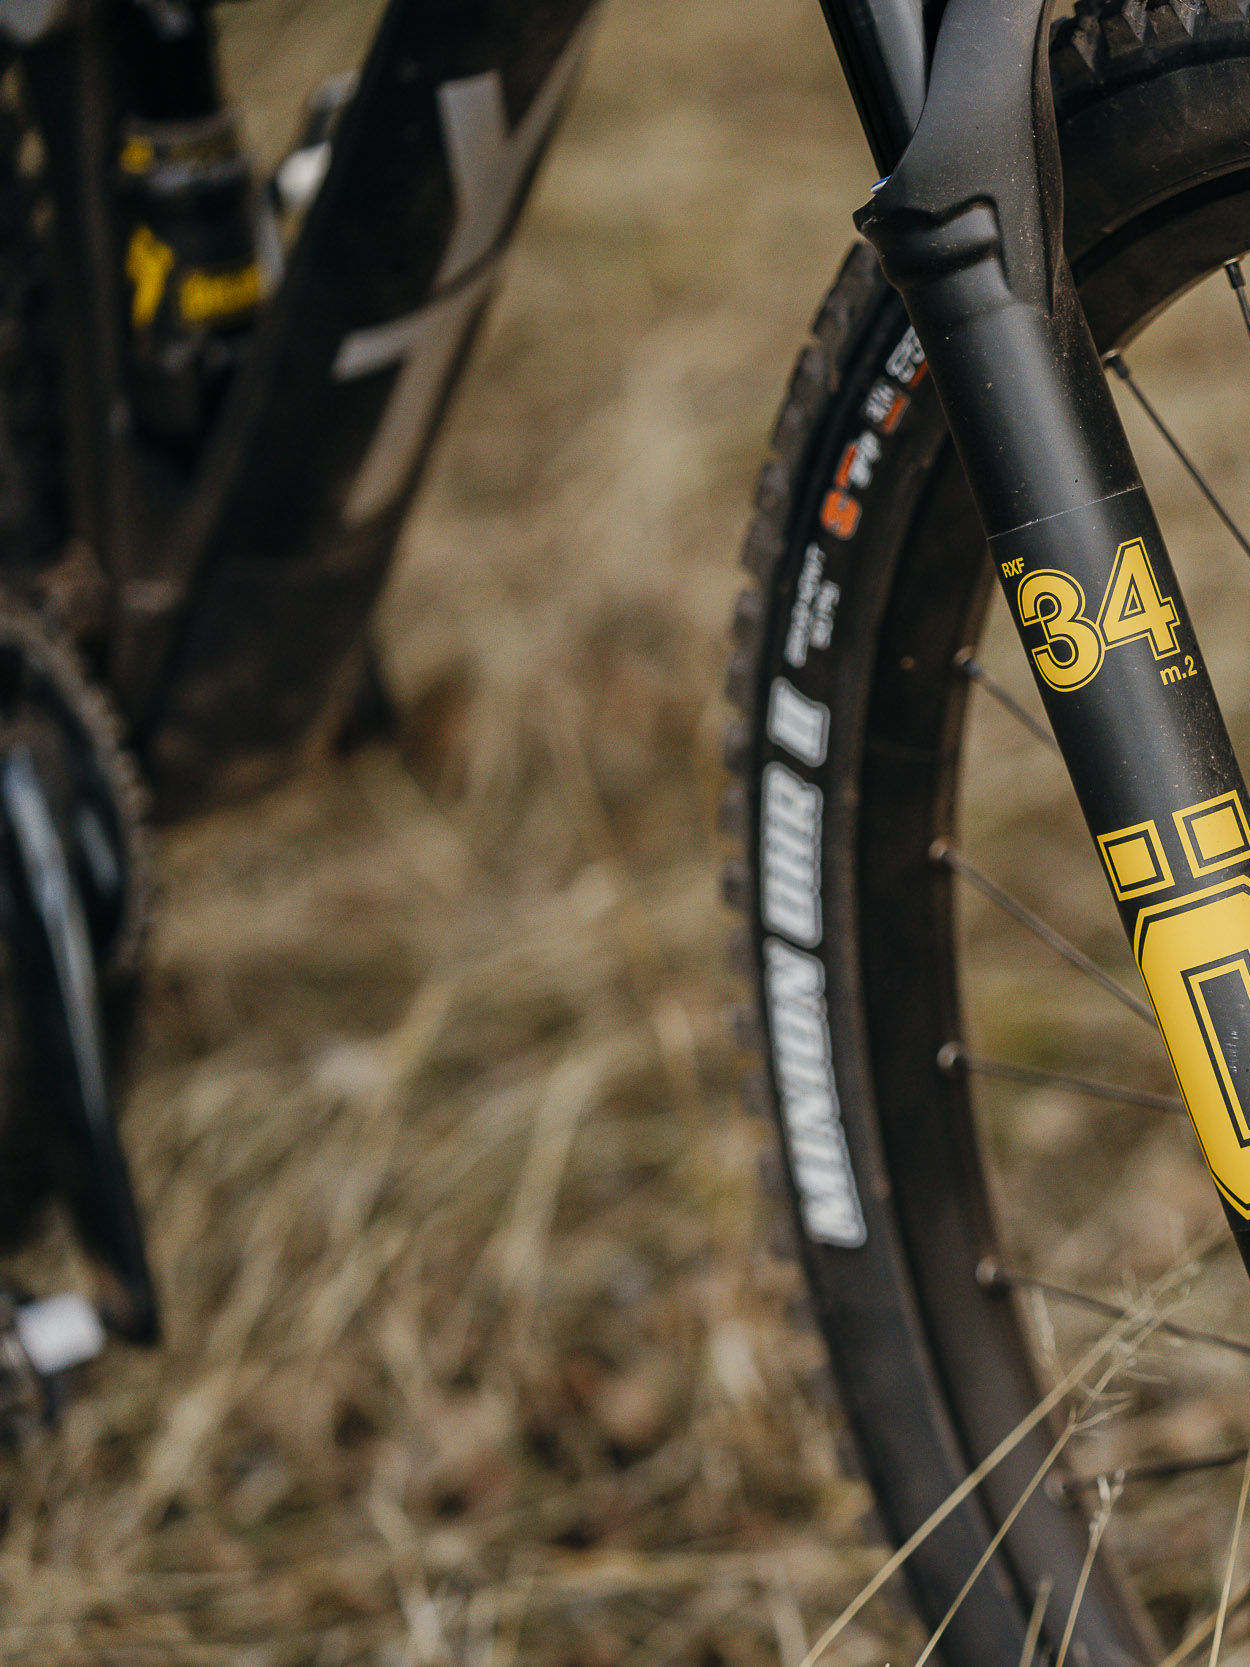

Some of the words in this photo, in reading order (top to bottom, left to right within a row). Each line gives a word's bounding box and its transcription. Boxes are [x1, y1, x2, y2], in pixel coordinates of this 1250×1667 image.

[1001, 556, 1025, 579] RXF
[1017, 537, 1182, 693] 34
[1159, 655, 1198, 687] m.2
[763, 936, 868, 1248] MINION
